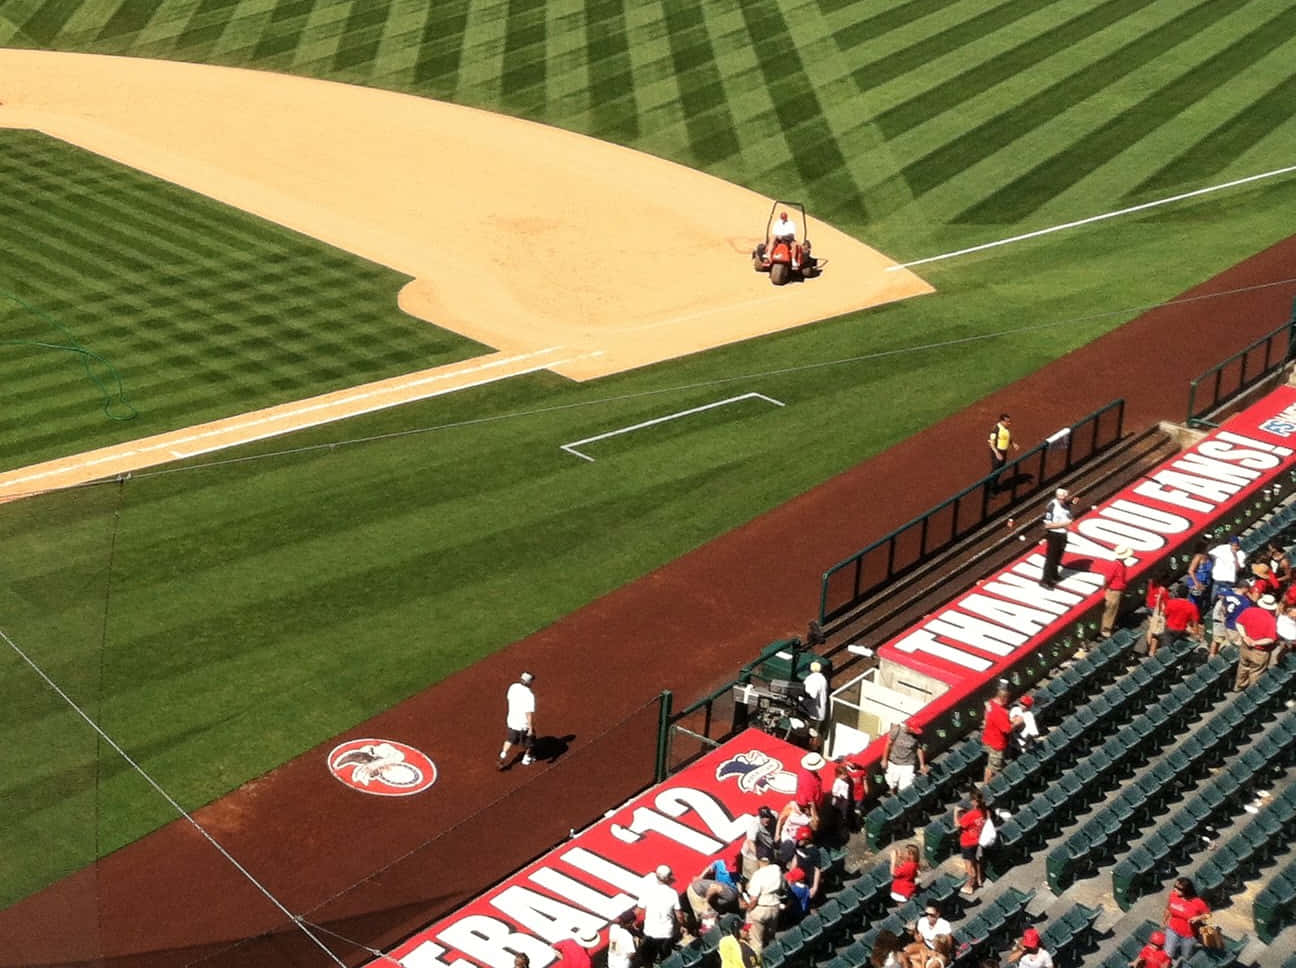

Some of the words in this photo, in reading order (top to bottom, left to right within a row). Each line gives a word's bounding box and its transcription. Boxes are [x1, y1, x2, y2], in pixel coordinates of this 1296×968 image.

[893, 553, 1106, 673] THANK
[1064, 499, 1191, 568] YOU
[1132, 430, 1295, 513] FANS!
